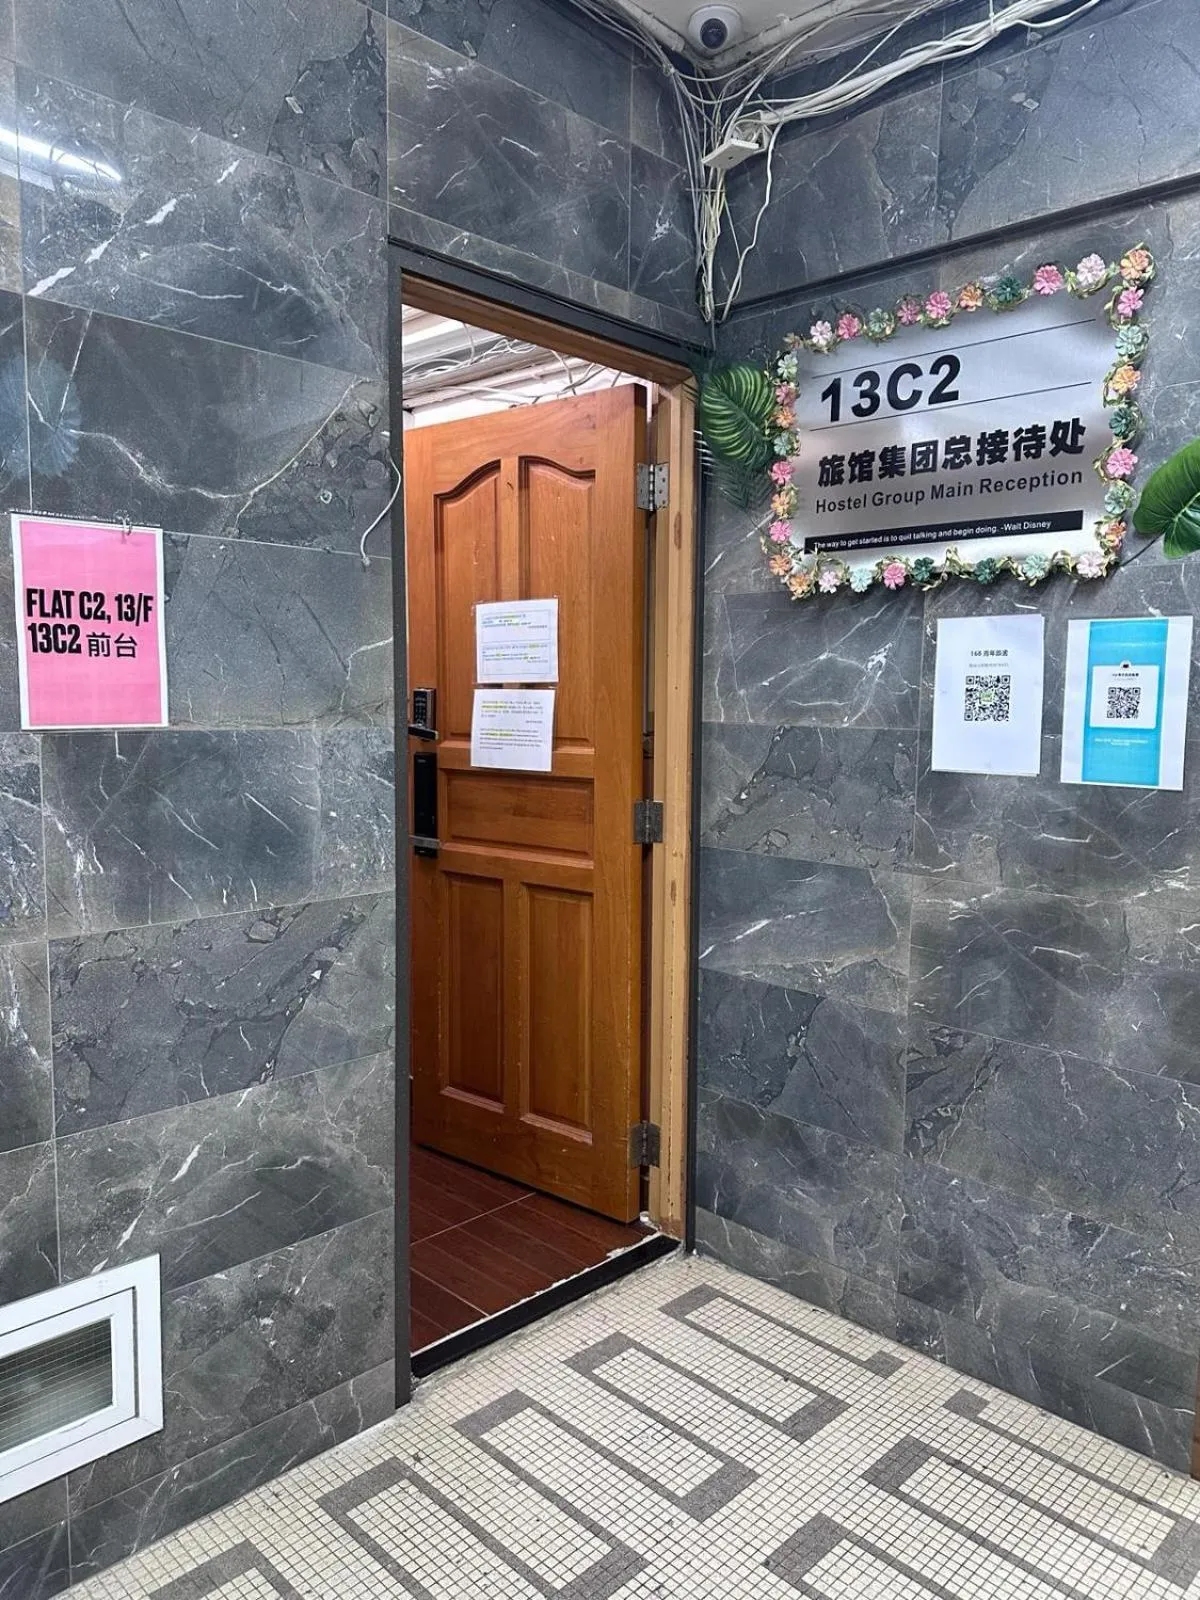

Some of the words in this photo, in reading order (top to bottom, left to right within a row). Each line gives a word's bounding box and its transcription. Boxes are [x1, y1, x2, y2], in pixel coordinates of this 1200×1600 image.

[820, 354, 961, 423] 13C2
[817, 417, 1087, 487] 旅馆集团总接待处
[816, 493, 867, 514] Hostel
[872, 490, 925, 506] Group
[930, 482, 973, 500] Main
[979, 470, 1083, 494] Reception
[826, 541, 839, 549] way
[847, 539, 859, 548] get
[859, 536, 883, 545] started
[913, 531, 937, 540] talking
[938, 529, 952, 537] and
[953, 527, 974, 537] begin
[1023, 520, 1052, 530] Disney
[26, 587, 74, 619] FLAT
[79, 591, 111, 624] C2,
[114, 592, 154, 626] 13/F
[27, 622, 82, 654] 13C2
[86, 632, 138, 658] 前台
